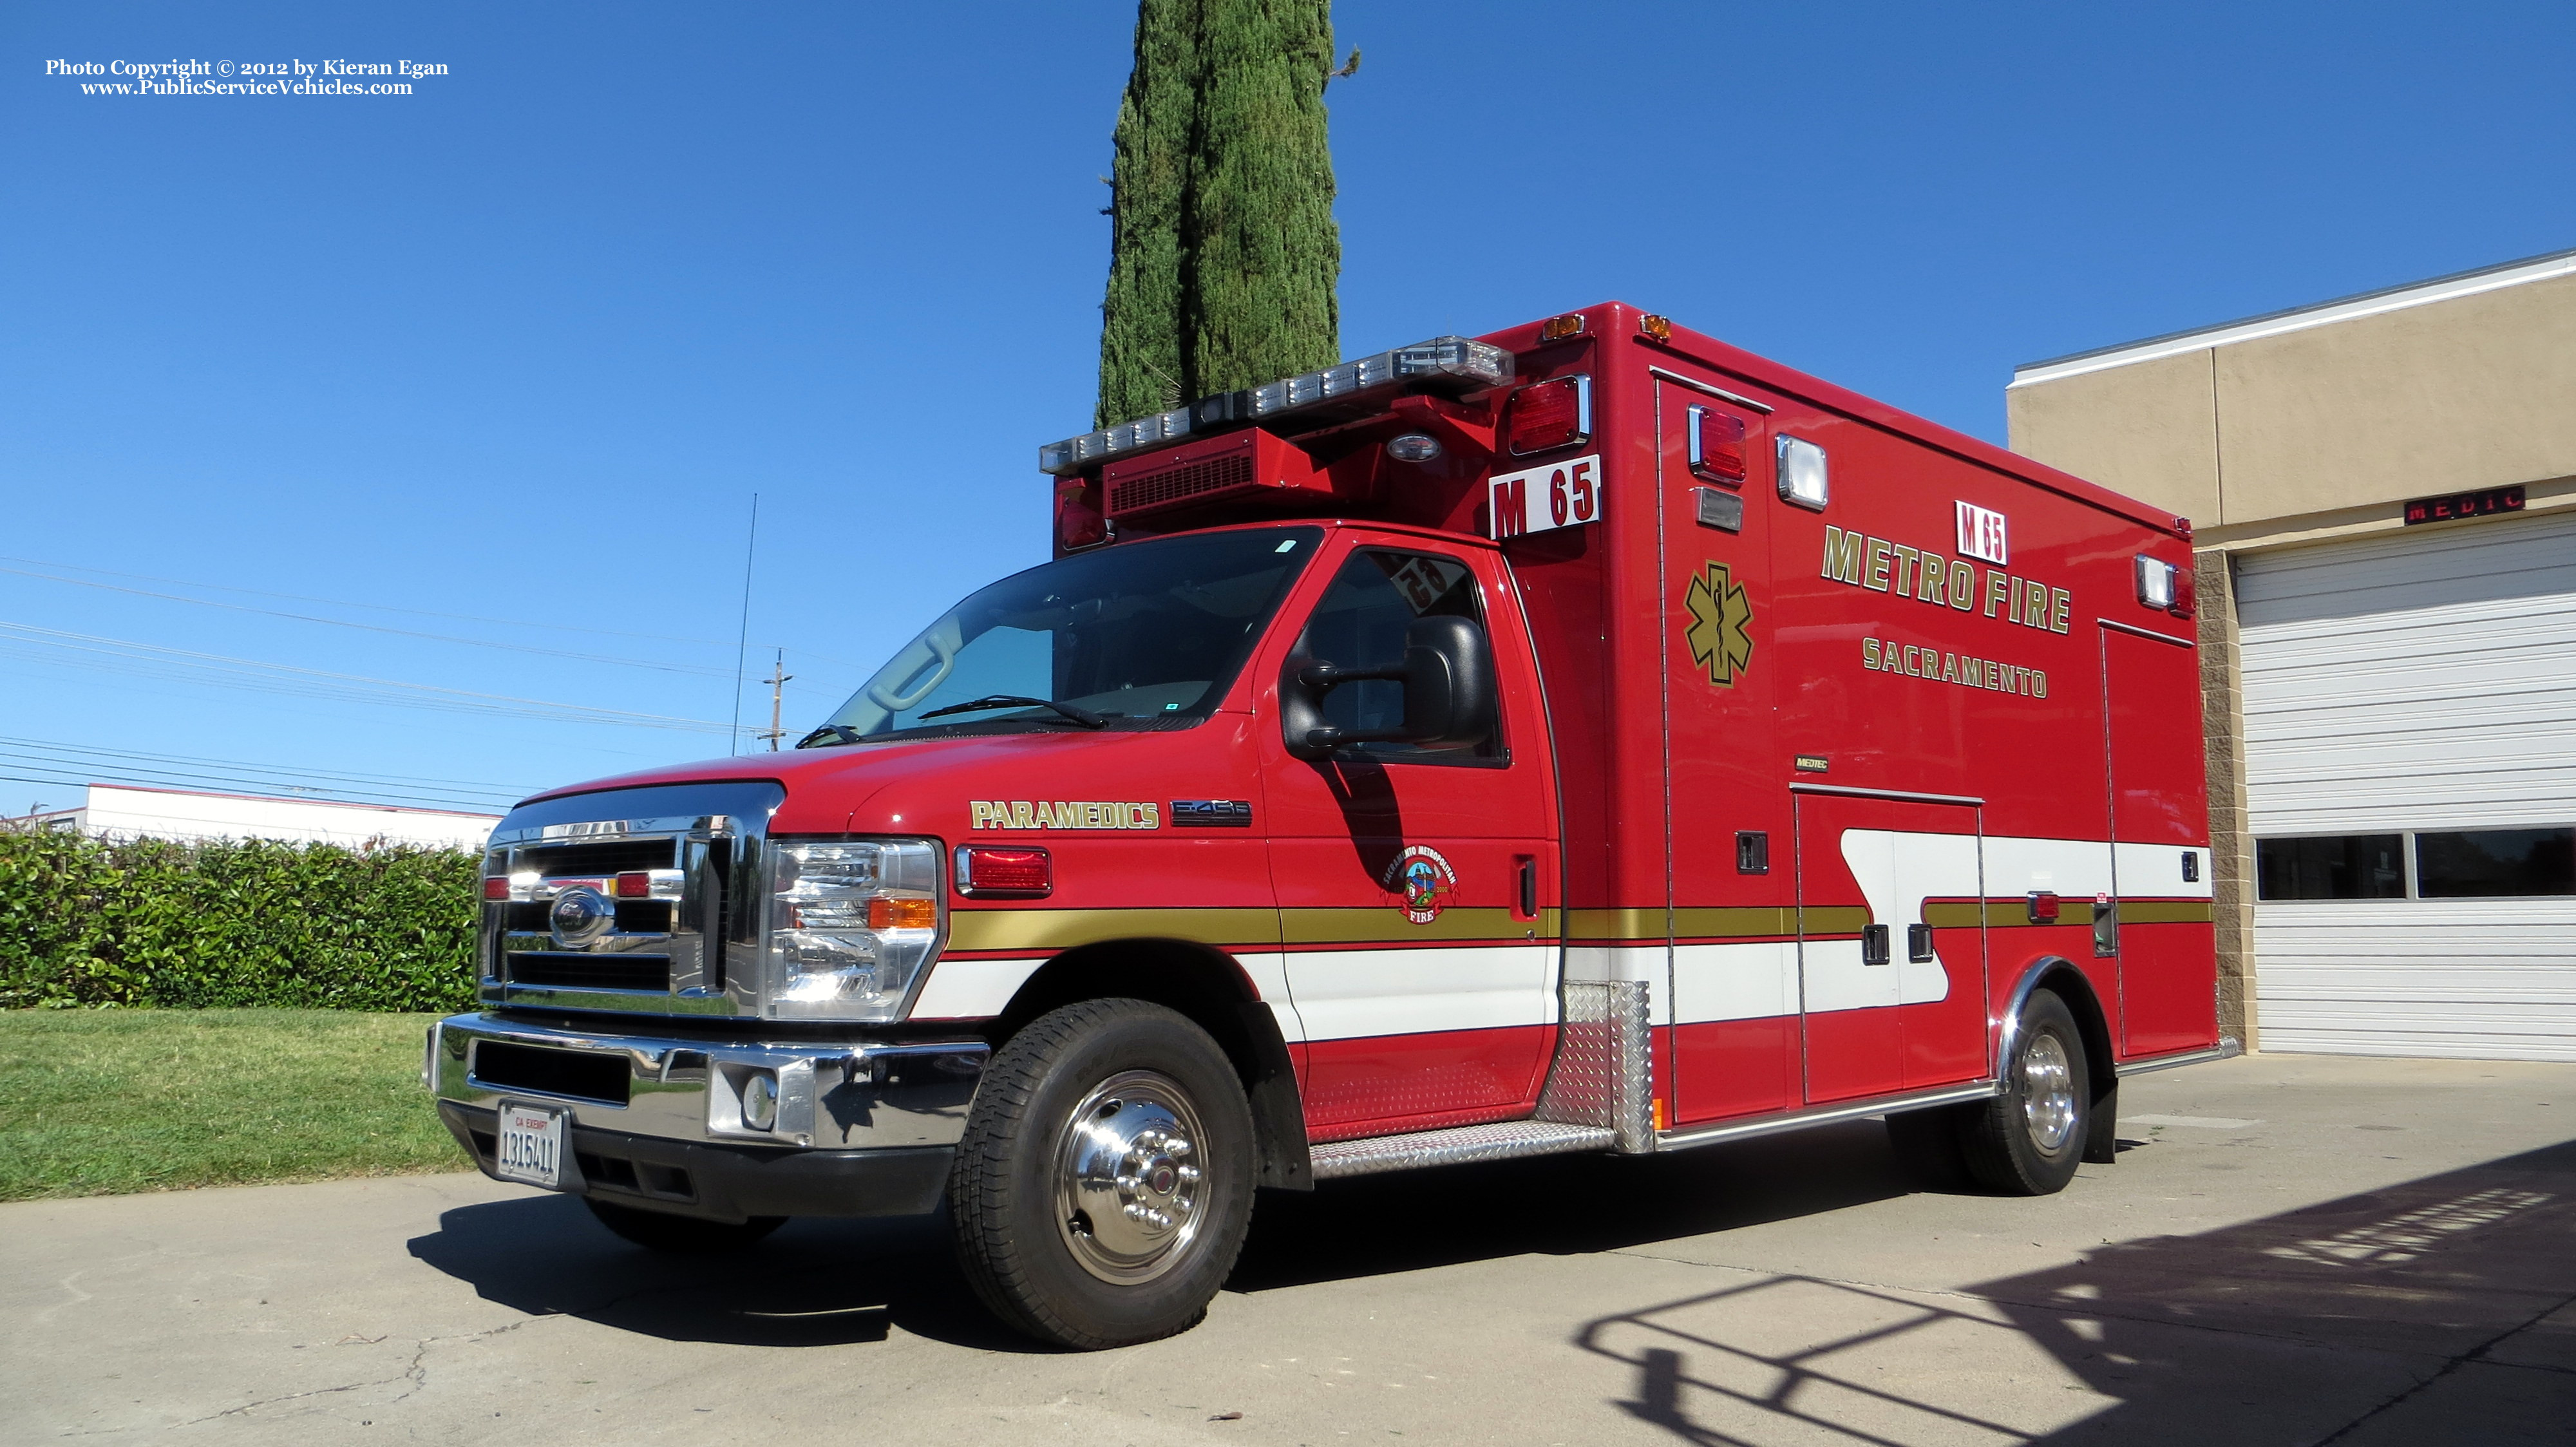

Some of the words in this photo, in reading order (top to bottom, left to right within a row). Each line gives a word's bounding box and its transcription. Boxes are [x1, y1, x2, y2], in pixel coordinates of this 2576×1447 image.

[1494, 478, 1527, 540] M
[1550, 462, 1594, 526] 65
[2409, 493, 2521, 520] MEDIC
[1962, 505, 1976, 554] M
[1983, 513, 2003, 561] 65
[1821, 525, 1975, 611] METRO
[1984, 569, 2070, 634] FIRE
[1862, 637, 2048, 699] SACRAMENTO
[1797, 757, 1828, 769] MEDTEC
[970, 800, 1159, 829] PARAMEDICS
[1383, 846, 1416, 885] SACRAMENTO
[1418, 846, 1456, 884] METROPOLITAN
[1410, 909, 1434, 923] FIRE
[502, 1131, 554, 1172] 1315411
